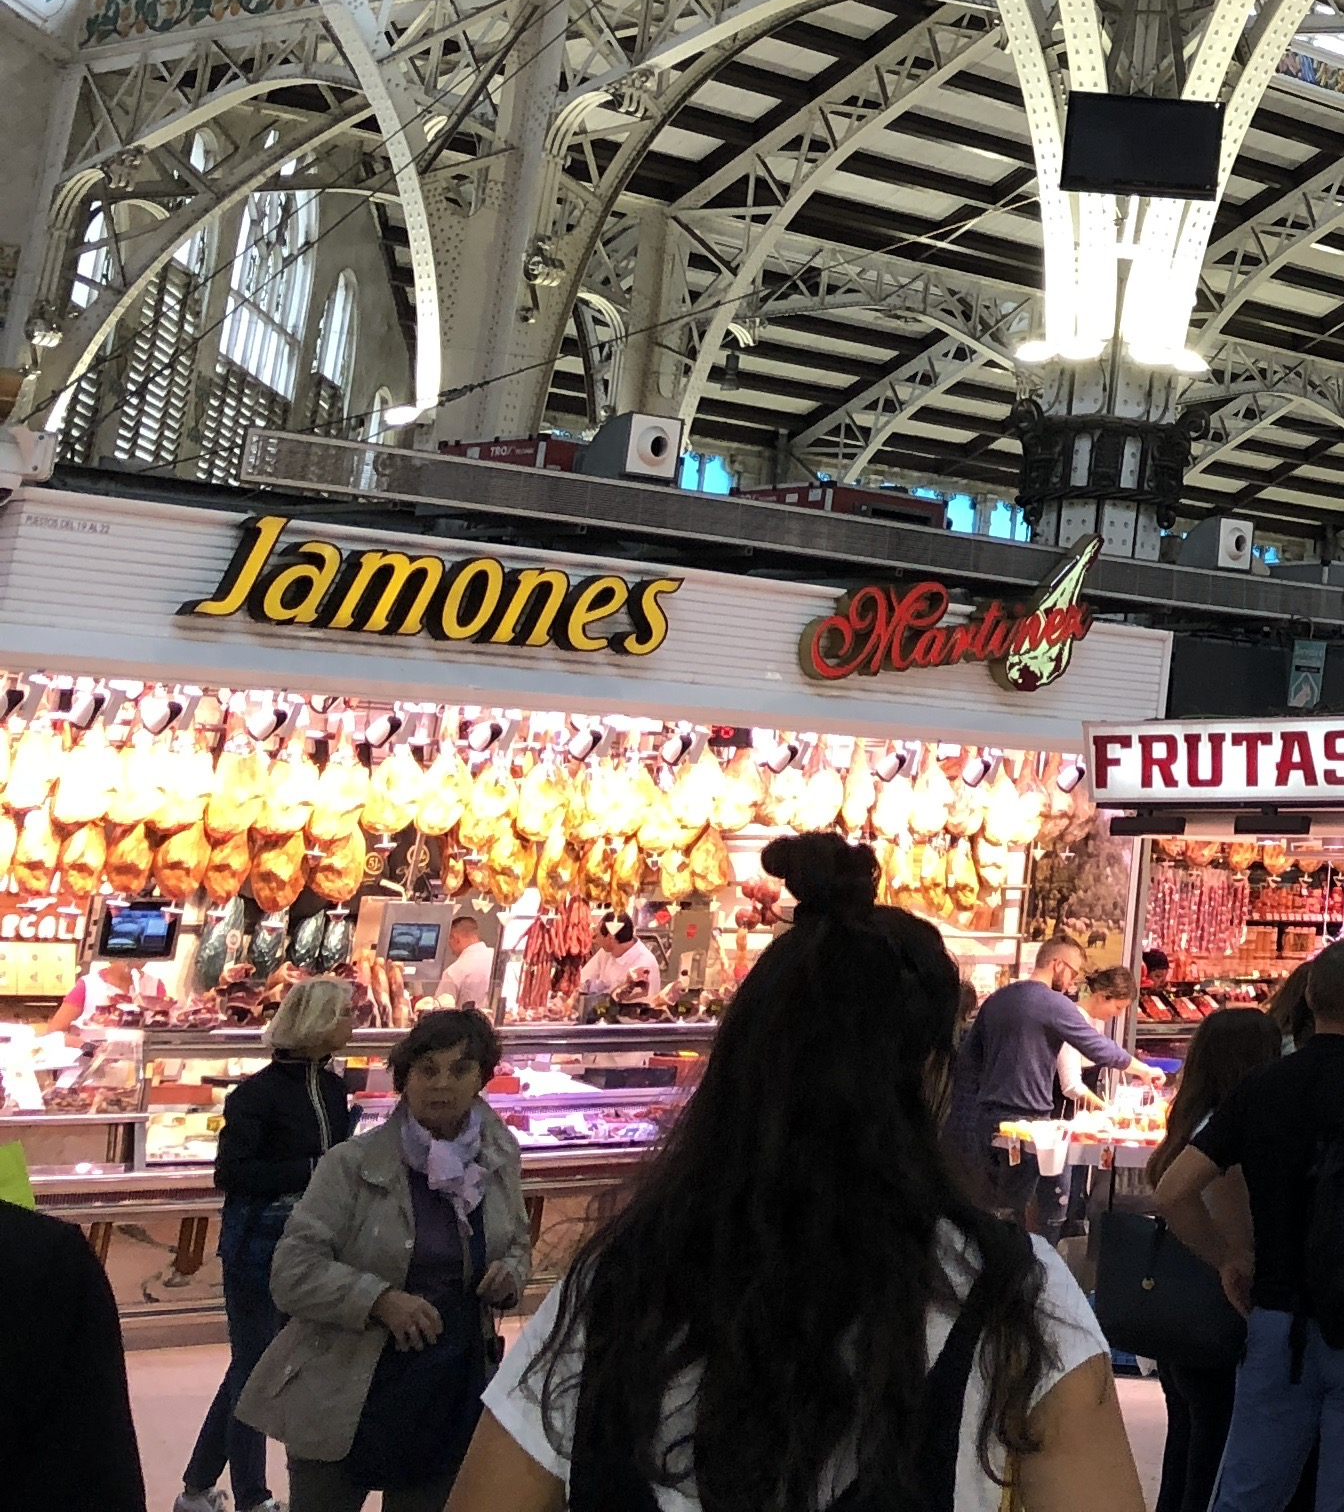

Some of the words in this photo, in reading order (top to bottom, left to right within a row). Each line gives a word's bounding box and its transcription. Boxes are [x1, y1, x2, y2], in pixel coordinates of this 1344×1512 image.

[77, 521, 87, 531] 19
[100, 523, 111, 535] 22
[192, 515, 686, 656] Jamones
[810, 580, 1092, 679] Martinez
